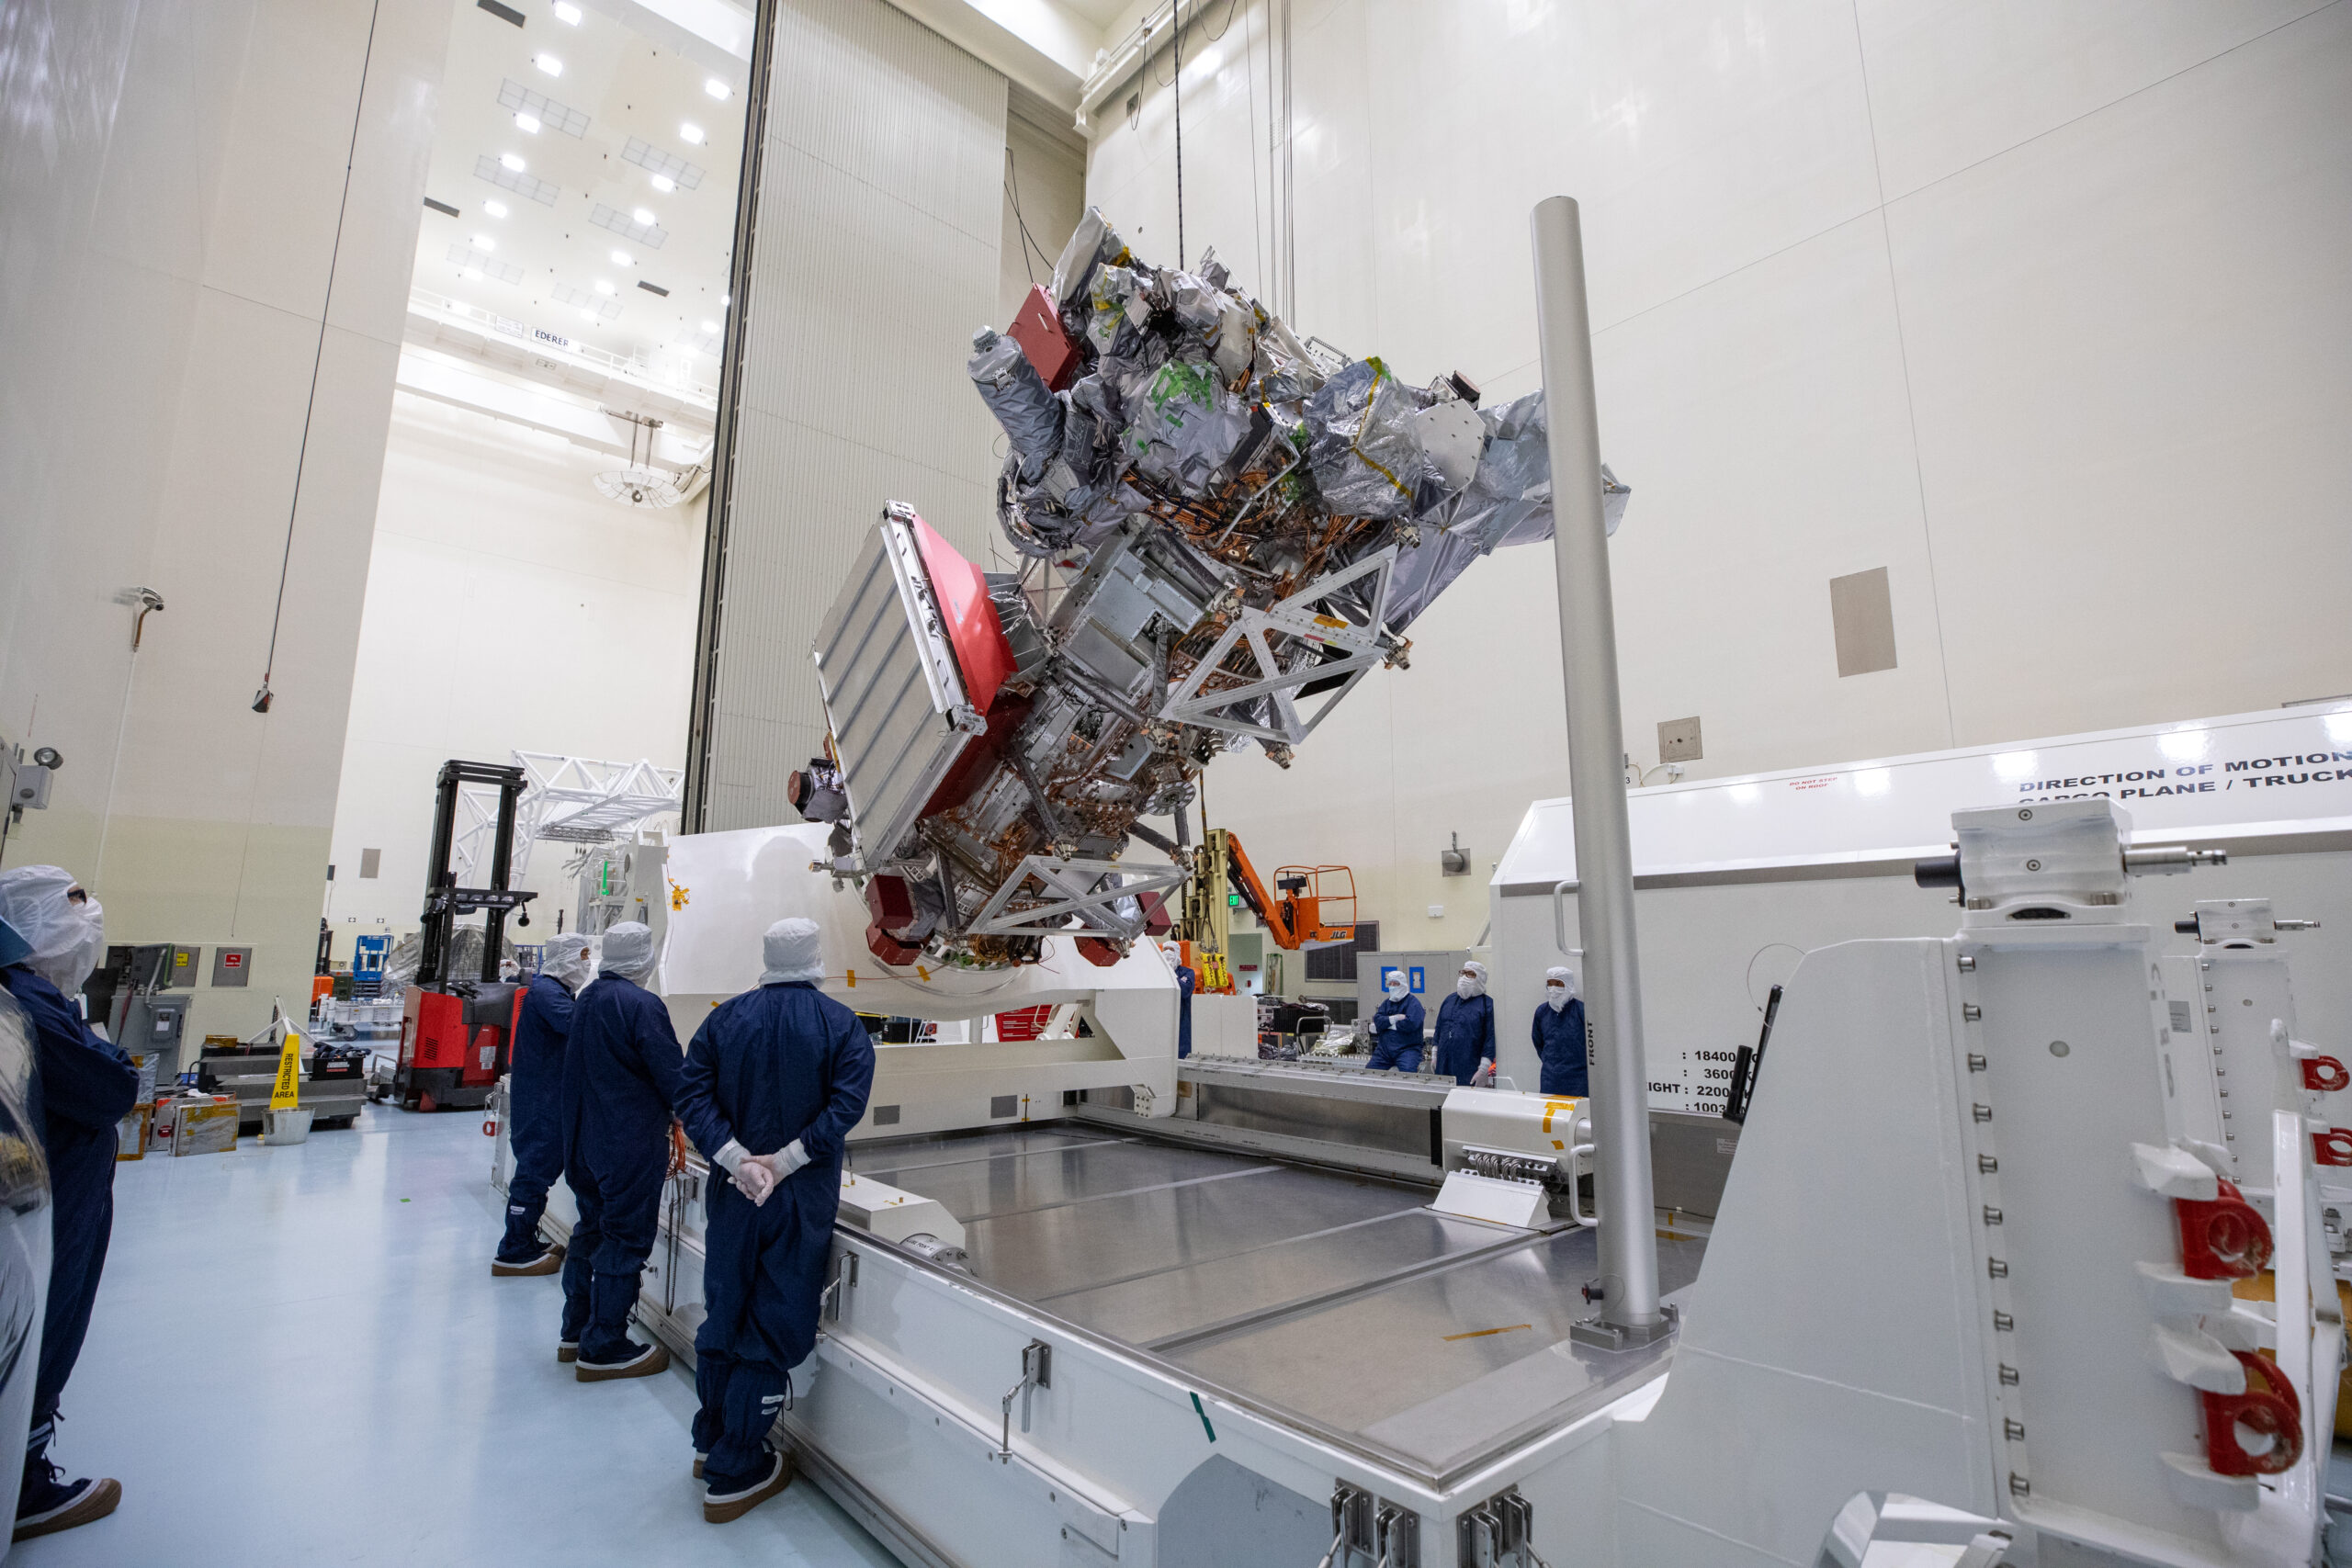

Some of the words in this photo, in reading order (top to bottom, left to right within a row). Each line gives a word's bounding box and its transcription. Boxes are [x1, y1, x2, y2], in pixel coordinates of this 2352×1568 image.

[535, 330, 569, 346] EDERER
[2019, 769, 2165, 793] DIRECTION
[2176, 763, 2214, 777] OF
[2224, 751, 2352, 773] MOTION
[2120, 781, 2216, 800] PLANE
[2226, 779, 2233, 791] /
[2243, 768, 2352, 789] TRUCK
[1229, 896, 1239, 906] EXIT
[1329, 931, 1347, 939] JLG
[1587, 1021, 1595, 1066] FRONT
[1695, 1050, 1736, 1062] 18400
[281, 1053, 294, 1090] RESTRICTED
[1646, 1082, 1680, 1094] IGHT
